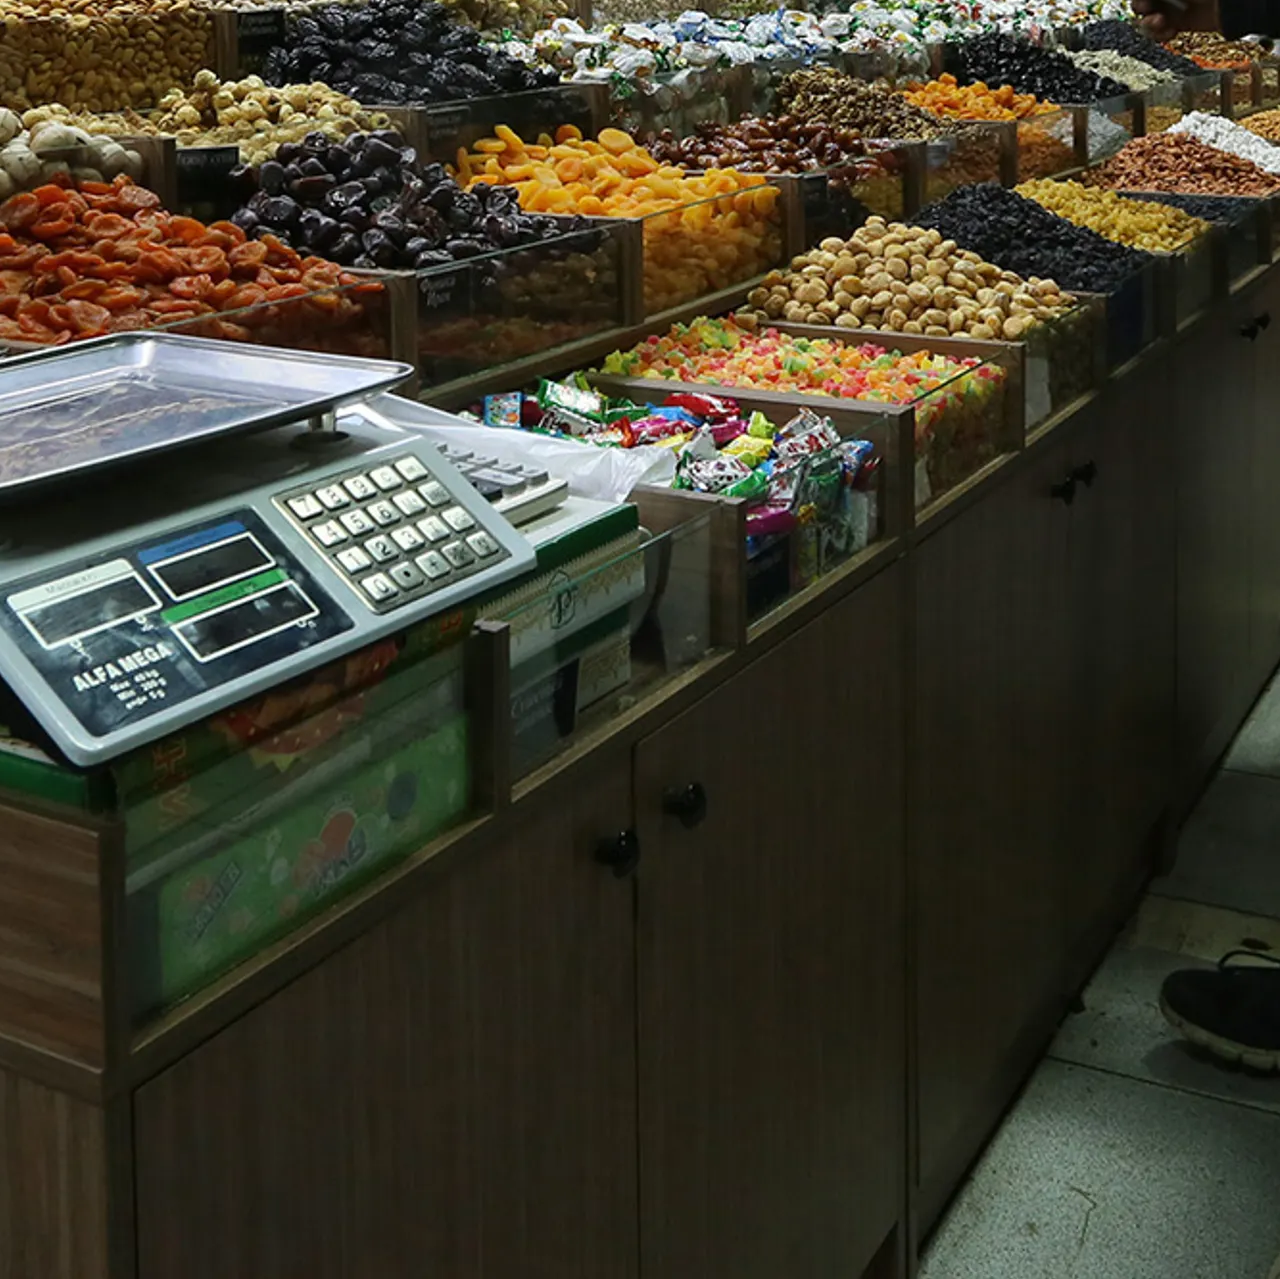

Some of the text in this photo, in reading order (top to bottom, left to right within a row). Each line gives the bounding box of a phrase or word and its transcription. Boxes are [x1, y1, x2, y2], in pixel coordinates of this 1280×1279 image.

[377, 504, 392, 520] 6
[378, 541, 392, 556] 2
[72, 641, 174, 692] ALFA MEGA
